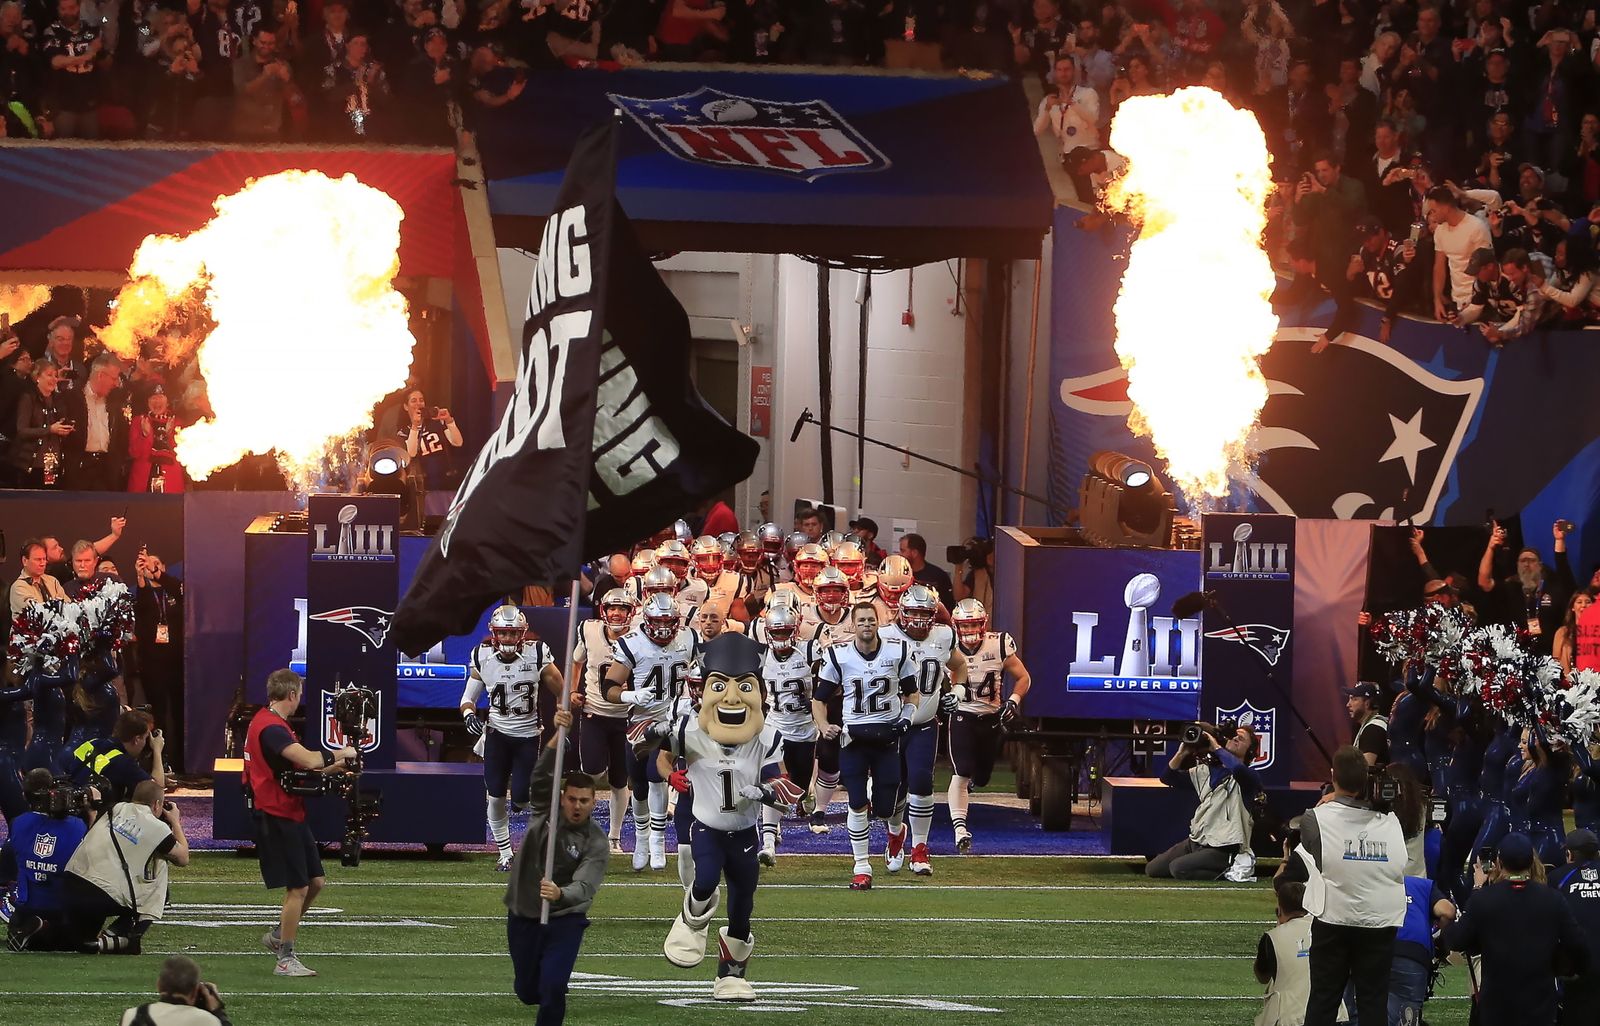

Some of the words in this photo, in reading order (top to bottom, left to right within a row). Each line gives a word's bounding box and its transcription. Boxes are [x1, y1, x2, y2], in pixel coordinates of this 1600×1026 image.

[663, 126, 871, 171] NFL
[420, 432, 443, 456] 12
[313, 523, 393, 554] LIII
[1209, 542, 1288, 572] LIII
[397, 667, 436, 678] OWL
[1104, 680, 1161, 689] SUPER
[489, 680, 537, 717] 43
[850, 675, 894, 715] 12
[717, 768, 738, 814] 1
[37, 843, 53, 854] NFL
[37, 861, 58, 872] FILMS
